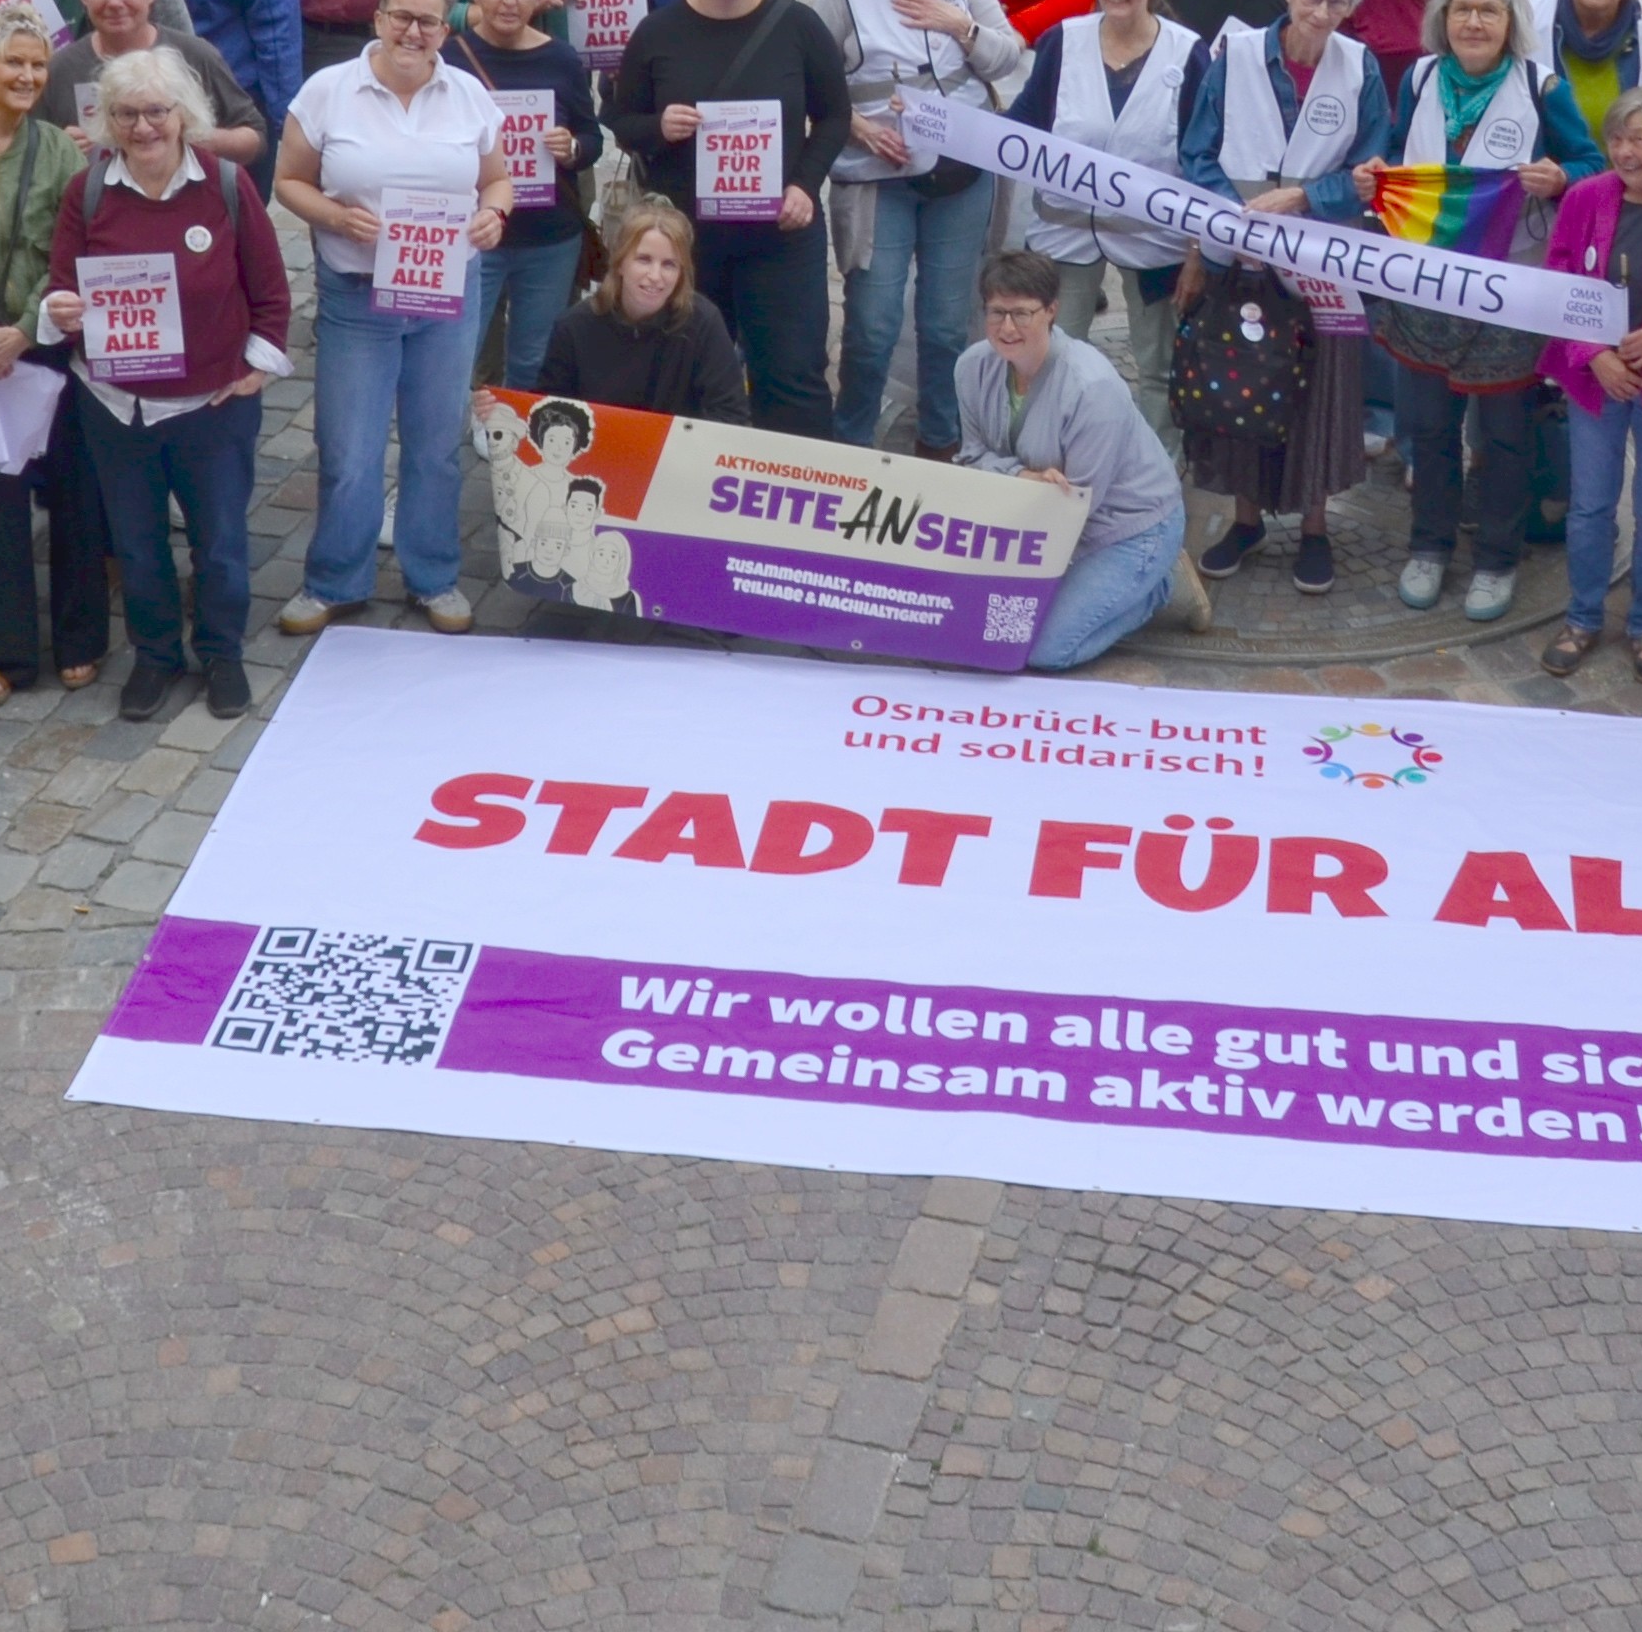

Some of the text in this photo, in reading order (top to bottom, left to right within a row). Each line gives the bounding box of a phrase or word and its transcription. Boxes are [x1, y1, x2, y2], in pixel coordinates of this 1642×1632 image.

[706, 134, 771, 151] STADT
[717, 151, 760, 172] FÜR
[713, 176, 761, 193] ALLE
[388, 223, 458, 245] STADT
[997, 134, 1508, 314] OMAS GEGEN RECHTS
[398, 244, 444, 267] FÜR
[391, 268, 444, 289] ALLE
[91, 287, 166, 307] STADT
[1570, 288, 1603, 302] OMAS
[108, 307, 156, 329] FÜR
[1566, 300, 1603, 315] GEGEN
[1563, 313, 1604, 329] RECHTS
[105, 332, 160, 353] ALLE
[715, 454, 868, 491] AKTIONSBÜNDNIS
[709, 475, 1048, 566] SEITE AN SEITE
[805, 592, 816, 605] &
[851, 695, 1267, 746] Osnabrück-bunt
[844, 730, 1264, 777] und solidarisch!
[412, 772, 992, 888] STADT
[1028, 813, 1388, 917] FÜR
[617, 975, 750, 1019] Wir
[768, 990, 1030, 1046] wollen
[1049, 1009, 1193, 1058] alle
[1212, 1024, 1348, 1079] gut
[1368, 1033, 1520, 1085] und
[601, 1027, 1068, 1102] Gemeinsam
[1089, 1057, 1296, 1120] aktiv
